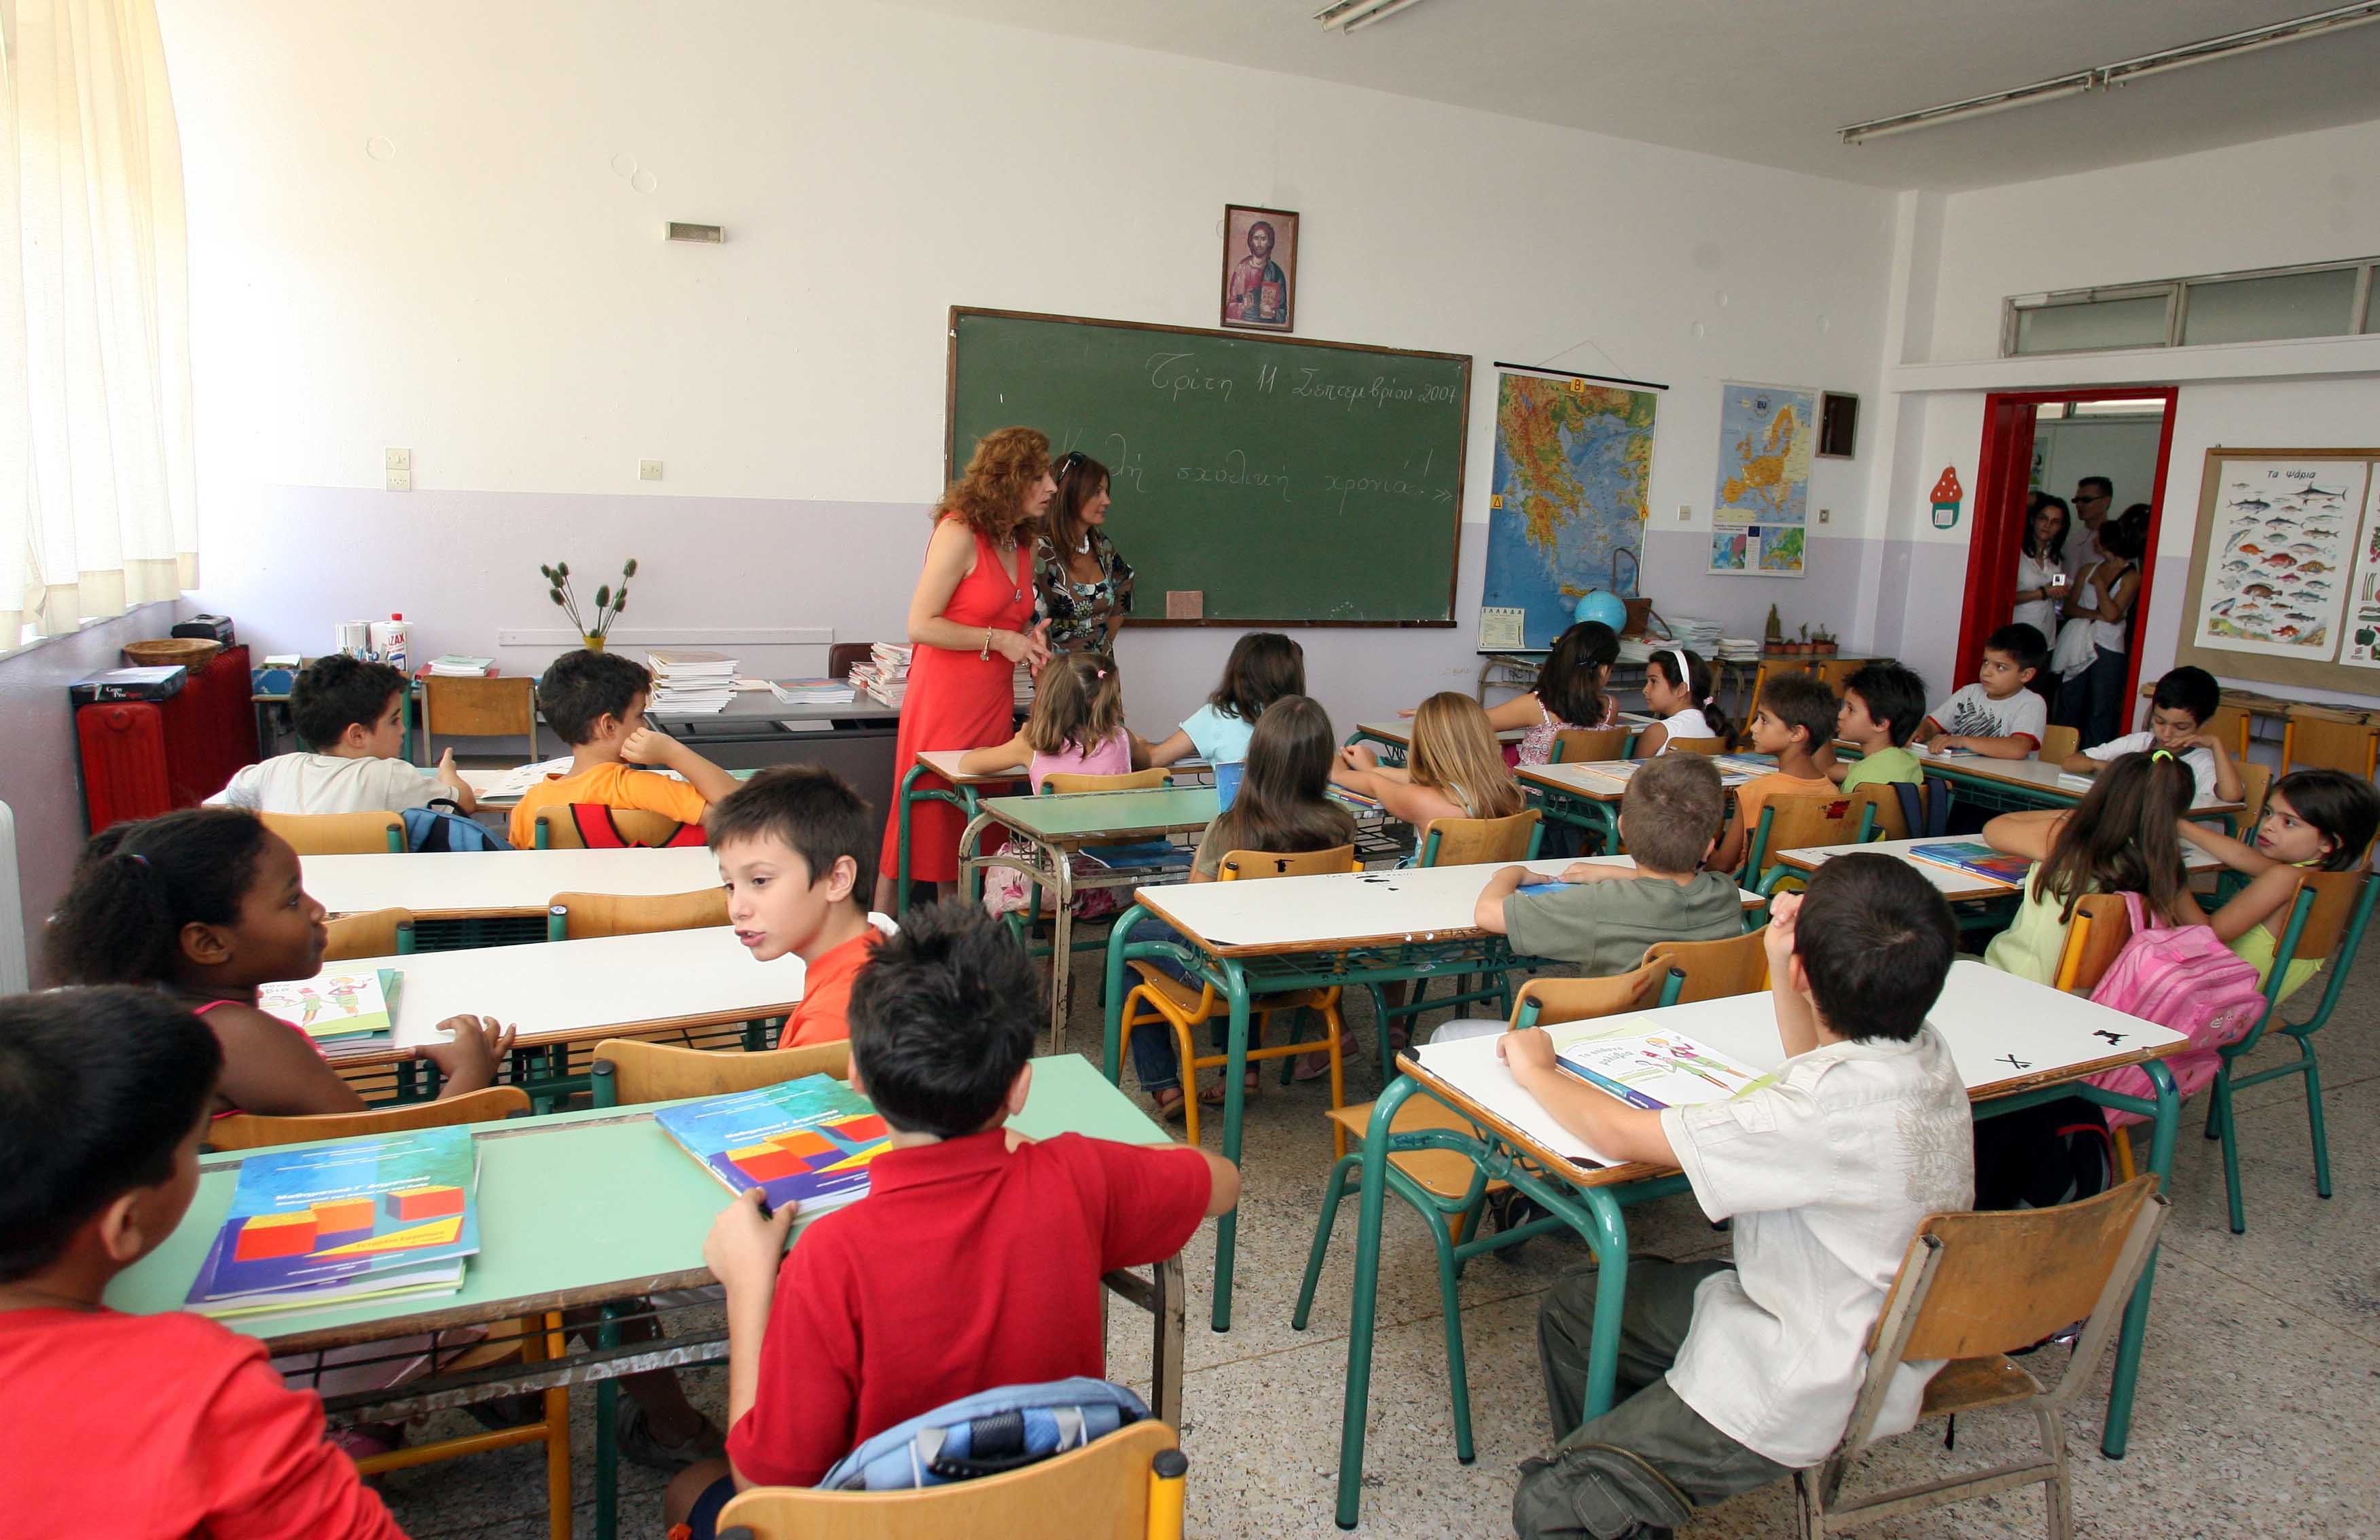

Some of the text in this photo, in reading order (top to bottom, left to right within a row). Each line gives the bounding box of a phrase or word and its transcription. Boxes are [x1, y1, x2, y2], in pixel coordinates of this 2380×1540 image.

[1145, 352, 1458, 412] Τρίτη 11 Σεπτεμβρίου 2007
[1756, 401, 1767, 409] EU
[1176, 449, 1292, 502] σχολική
[2267, 471, 2279, 479] Τα
